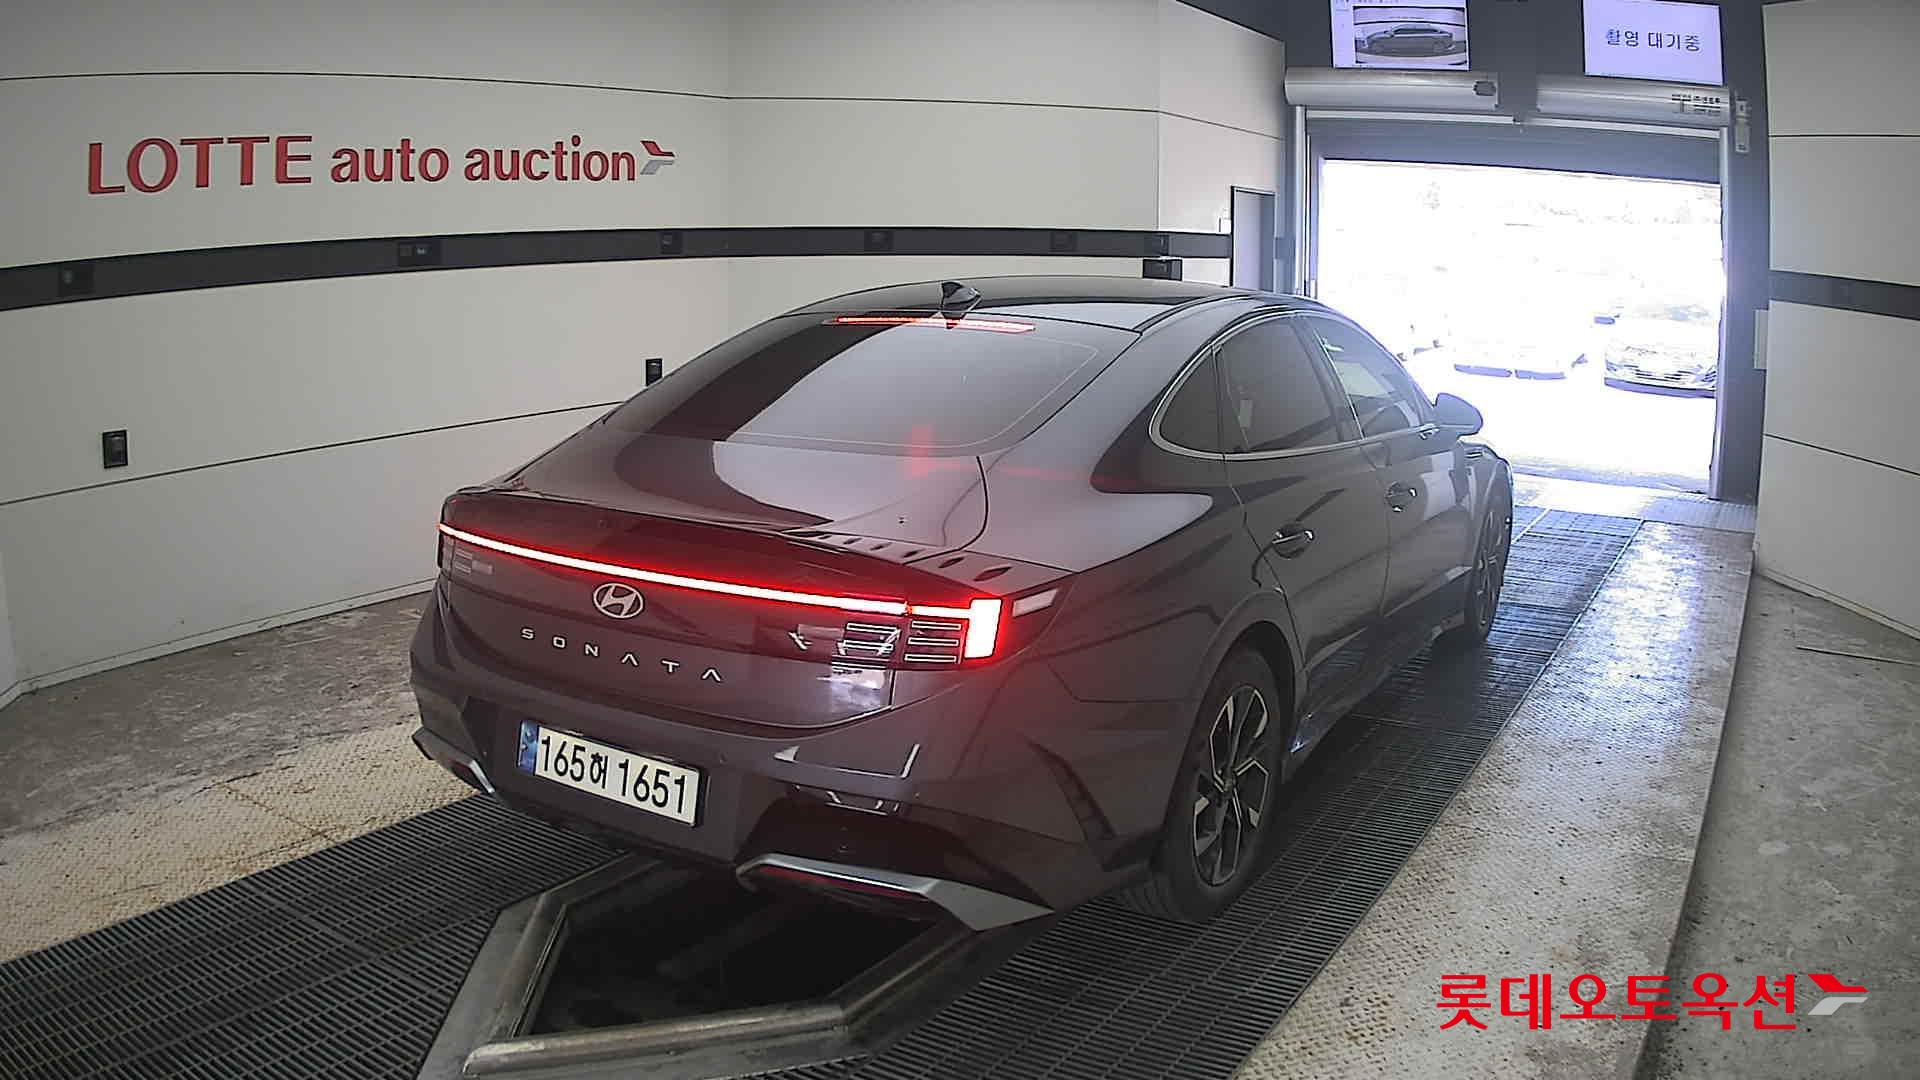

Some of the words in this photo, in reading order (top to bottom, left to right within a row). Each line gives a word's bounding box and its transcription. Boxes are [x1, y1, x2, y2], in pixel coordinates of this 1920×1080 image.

[1647, 31, 1701, 53] 대기중
[88, 135, 313, 195] LOTTE
[330, 138, 450, 183] auto
[463, 134, 637, 182] auction
[520, 627, 722, 683] SONATA
[541, 735, 610, 790] 165허
[618, 758, 687, 815] 1651
